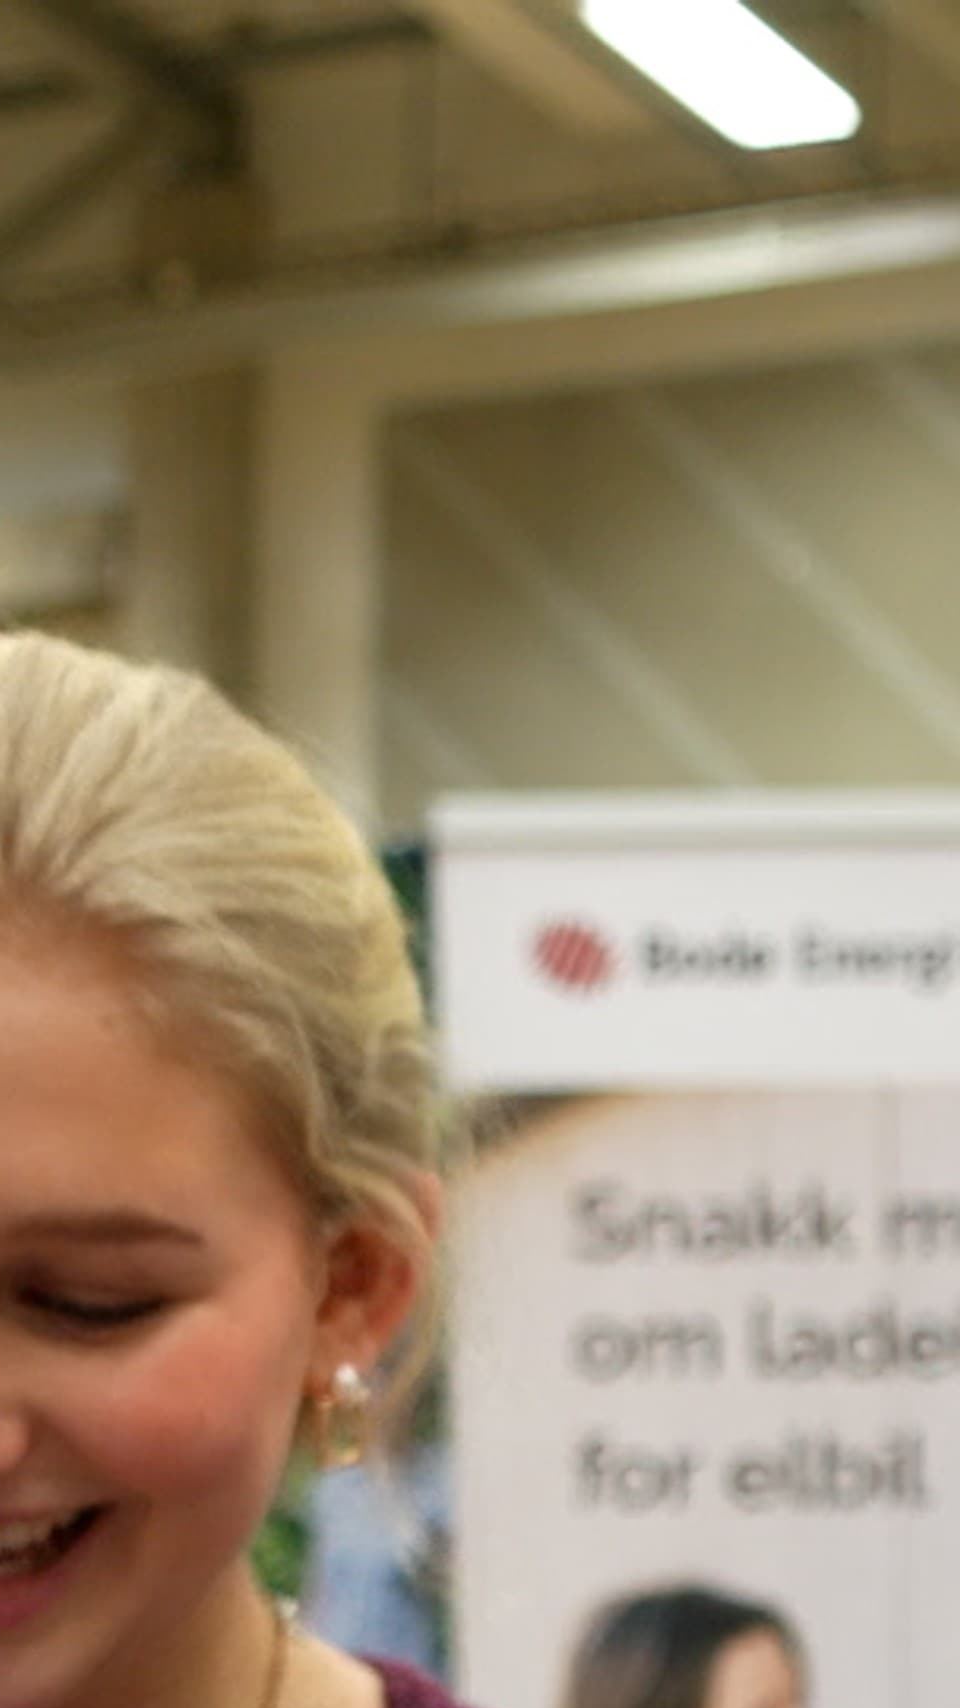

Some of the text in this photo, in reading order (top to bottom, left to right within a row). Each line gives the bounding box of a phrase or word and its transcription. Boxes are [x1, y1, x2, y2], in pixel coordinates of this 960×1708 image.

[797, 927, 960, 1000] Energ
[570, 1178, 852, 1265] Snakk
[570, 1315, 726, 1385] om
[572, 1424, 926, 1515] for elbil
